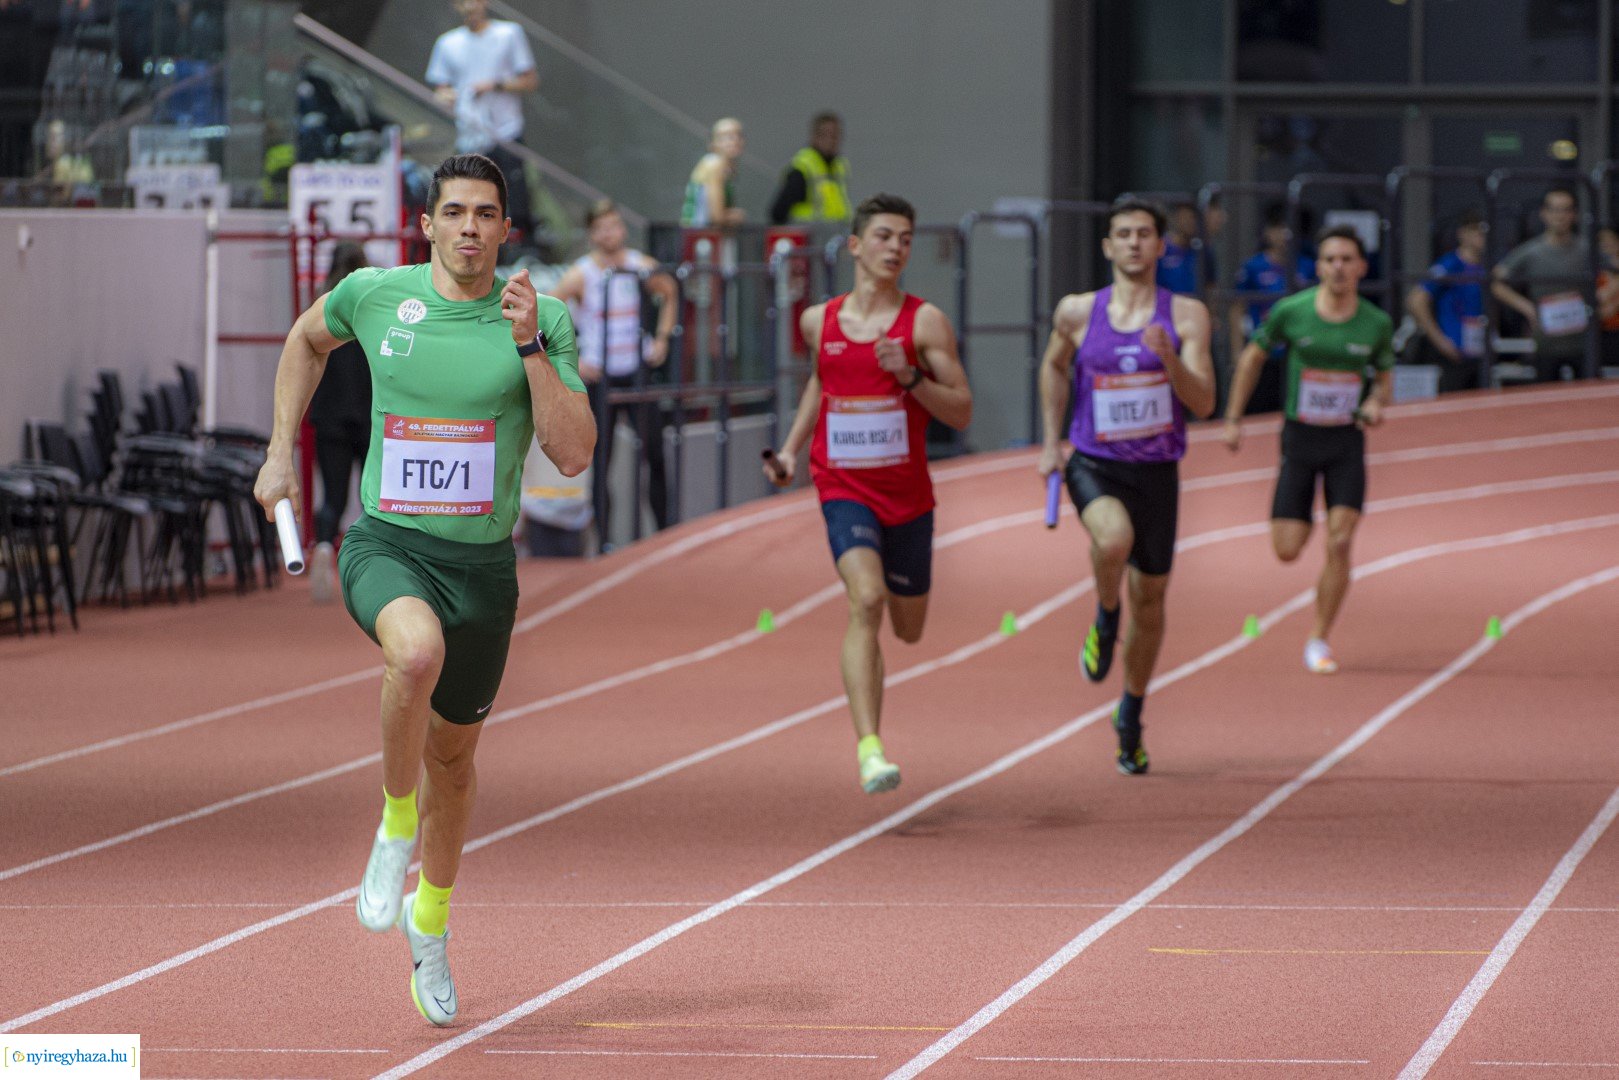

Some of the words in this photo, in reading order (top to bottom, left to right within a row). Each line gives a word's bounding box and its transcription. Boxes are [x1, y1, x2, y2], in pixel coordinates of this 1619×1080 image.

[390, 331, 411, 340] group
[1109, 399, 1158, 423] UTE/1
[408, 423, 421, 431] 49.
[423, 424, 485, 432] FEDETTPÁLYÁS
[402, 458, 470, 490] FTC/1
[391, 503, 458, 513] NYÍREGYHÁZA
[460, 505, 482, 513] 2023
